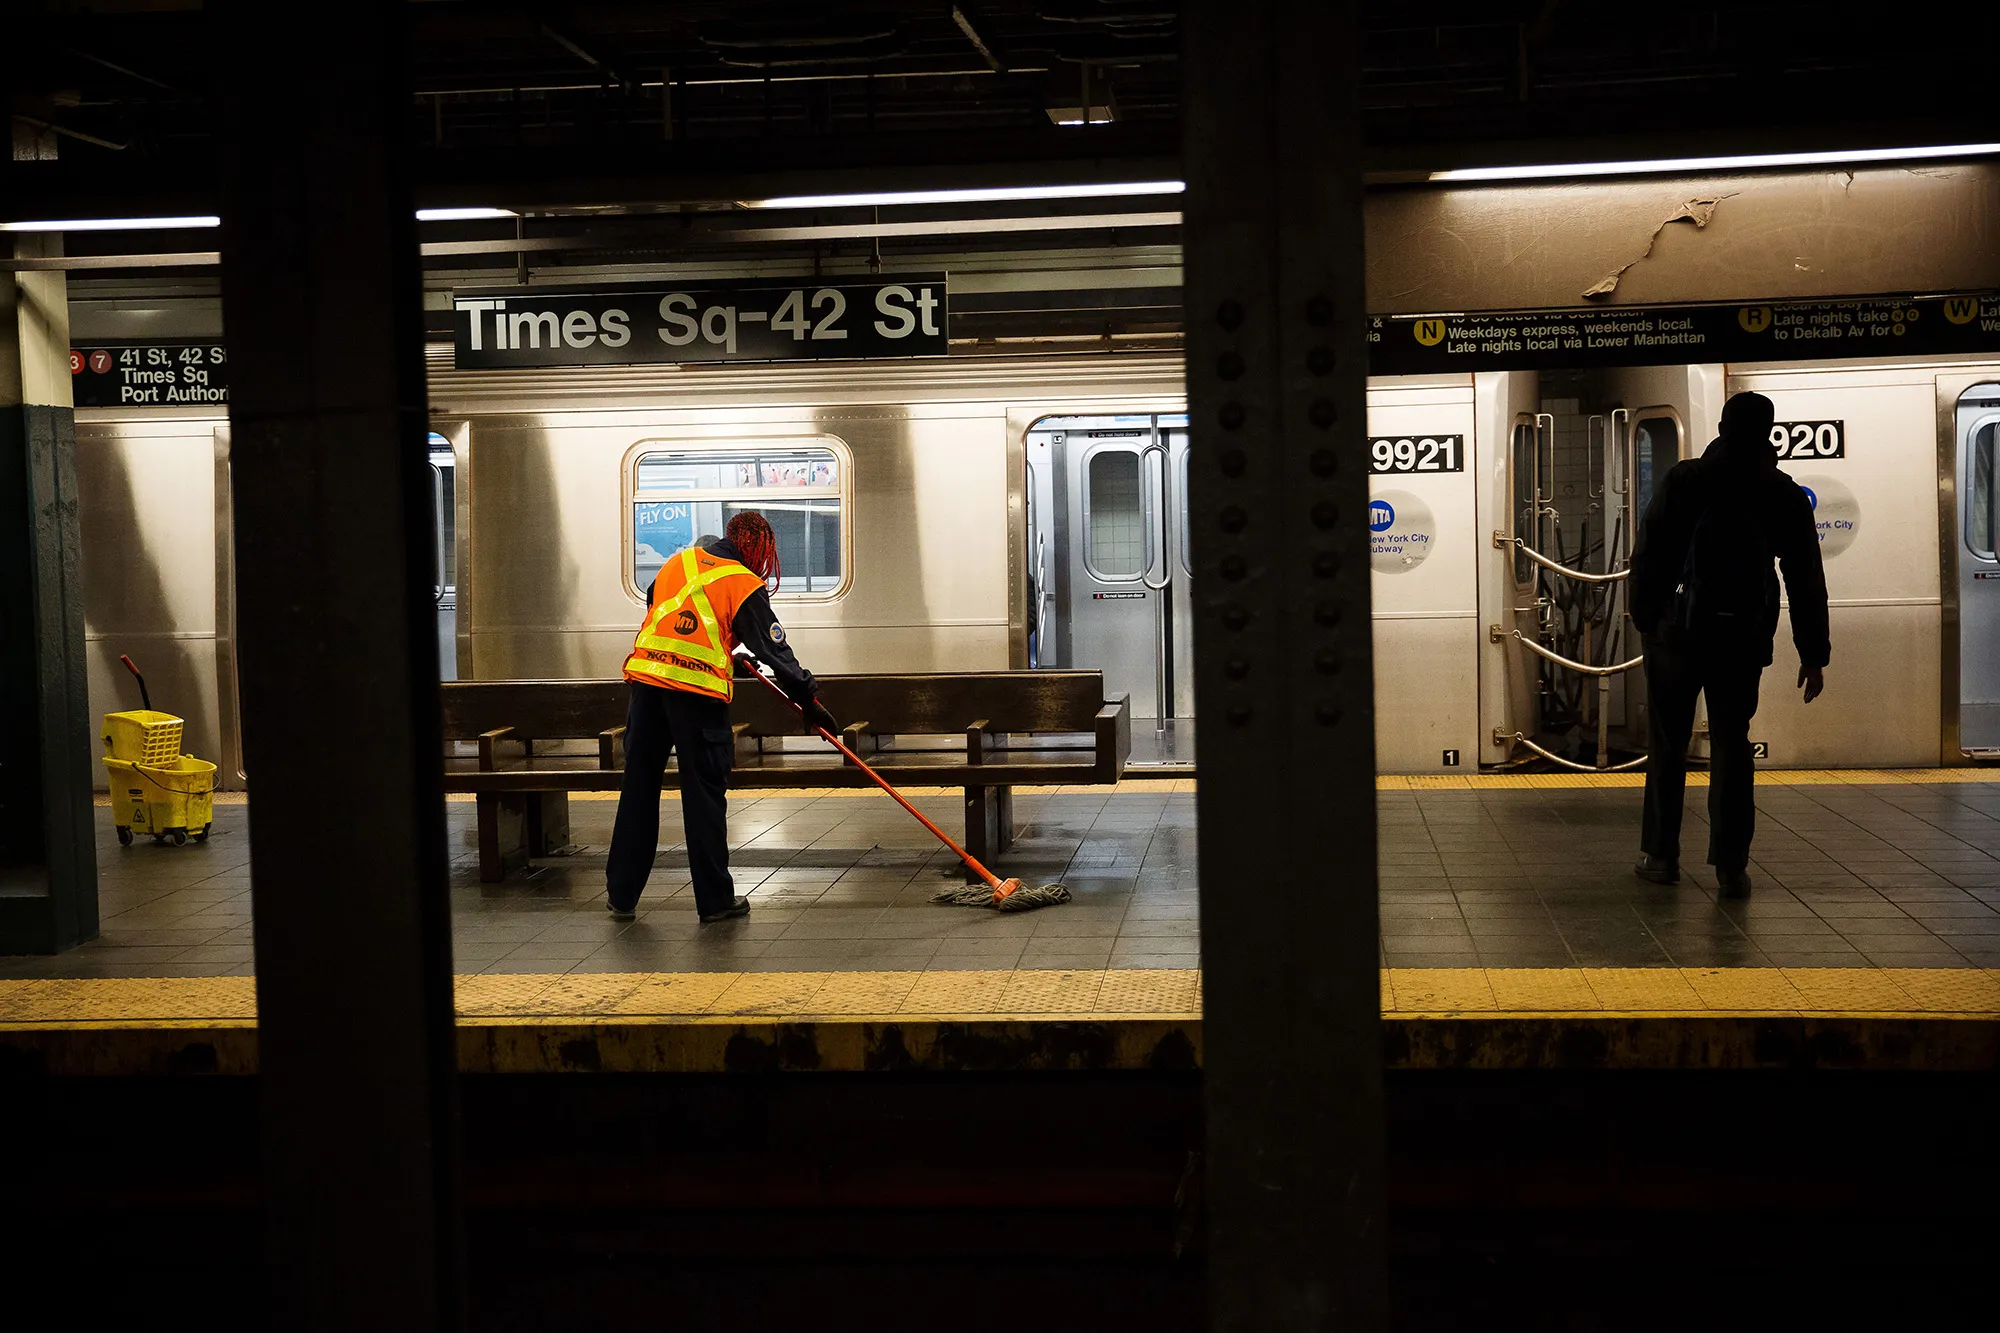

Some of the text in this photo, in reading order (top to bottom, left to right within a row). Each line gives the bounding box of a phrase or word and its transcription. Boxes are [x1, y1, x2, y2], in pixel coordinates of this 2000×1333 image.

[455, 285, 939, 354] Times Sq-42 St
[1373, 317, 1383, 328] &
[1773, 313, 1804, 326] Late
[1809, 312, 1852, 327] nights
[1857, 310, 1889, 322] take
[1447, 325, 1517, 340] Weekdays
[1522, 324, 1580, 338] express,
[1584, 319, 1654, 334] weekends
[1774, 328, 1789, 340] to
[1794, 325, 1842, 340] Dekalb
[1848, 325, 1865, 337] Av
[1870, 324, 1891, 337] for
[1447, 332, 1706, 354] Late nights local via Lower Manhattan
[95, 355, 105, 369] 7
[119, 349, 141, 365] 41
[147, 348, 172, 367] St,
[179, 347, 203, 364] 42
[120, 366, 209, 386] Times Sq
[121, 386, 159, 402] Port
[1371, 437, 1455, 471] 9921
[640, 509, 660, 525] FLY
[1815, 520, 1853, 530] ork City
[1387, 534, 1409, 543] York
[1411, 533, 1430, 543] City
[1446, 750, 1454, 765] 1
[1753, 743, 1765, 758] 2
